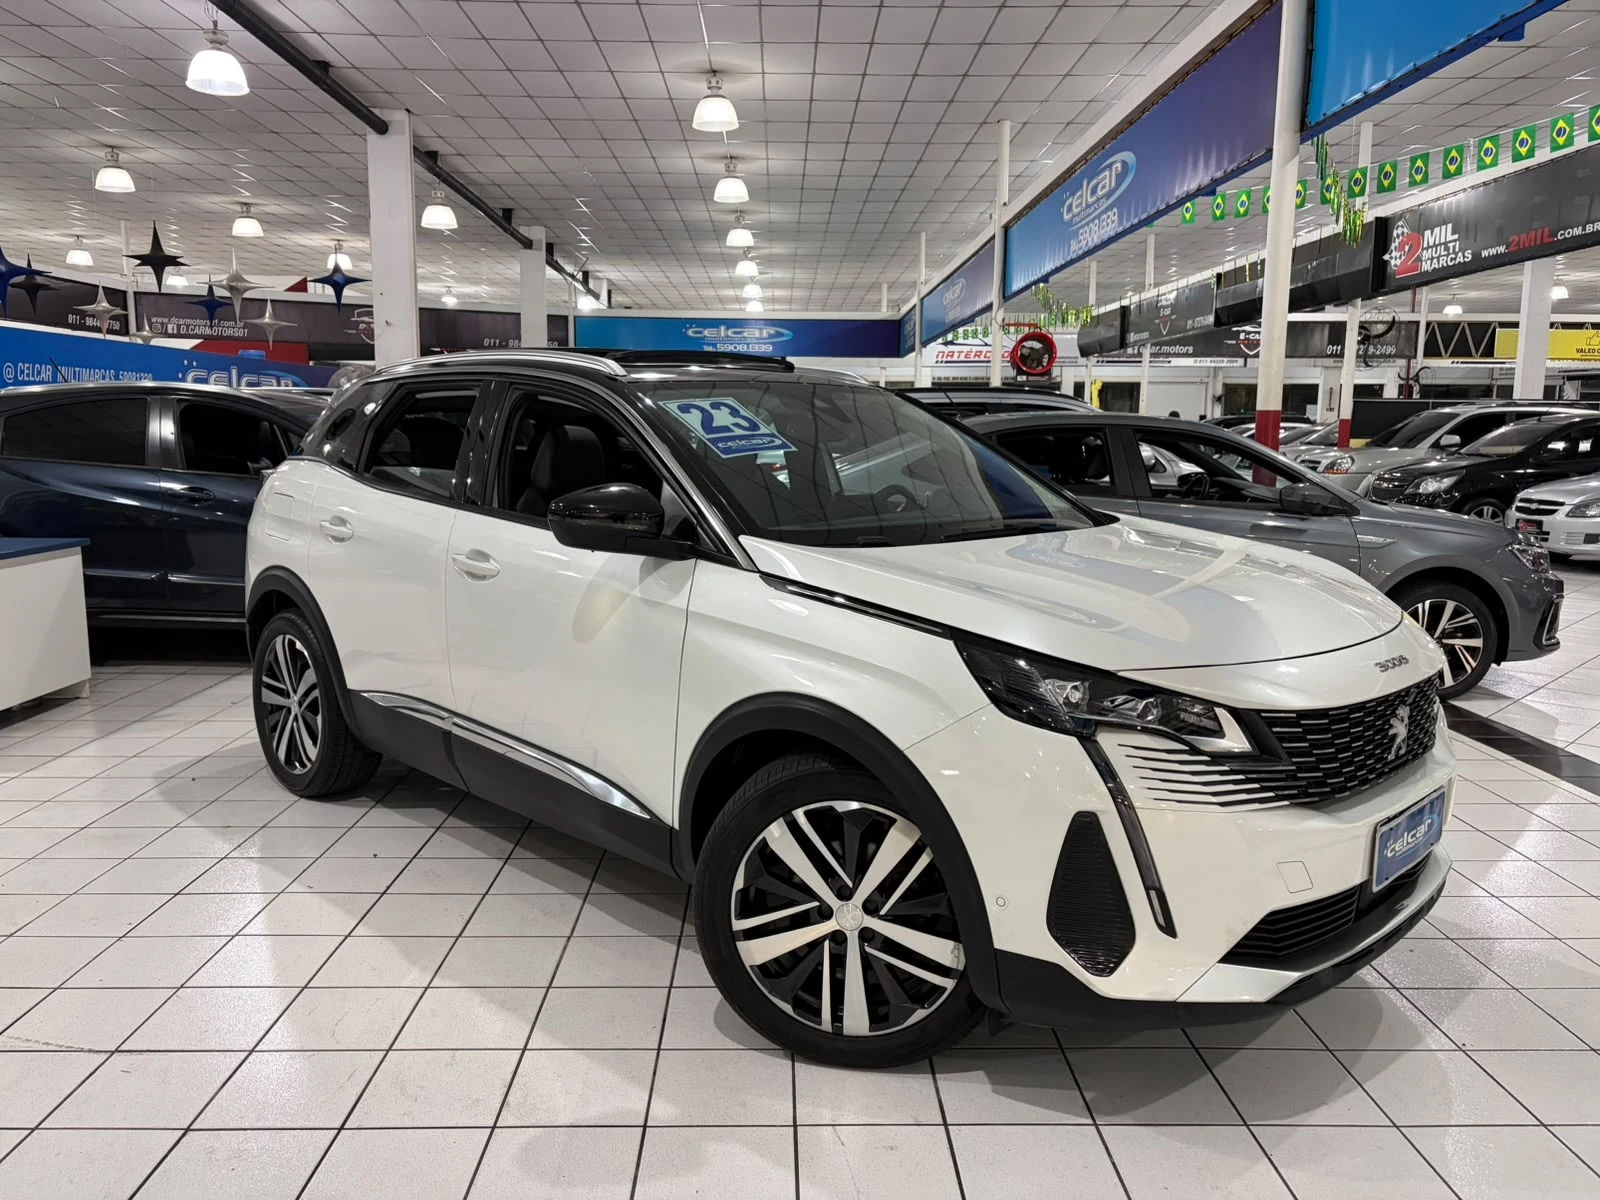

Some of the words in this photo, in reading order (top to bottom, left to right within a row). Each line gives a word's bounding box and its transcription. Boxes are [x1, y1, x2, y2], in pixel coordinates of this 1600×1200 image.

[1063, 159, 1123, 222] celcar
[1423, 223, 1459, 248] MIL
[1422, 241, 1460, 260] MULTI
[1421, 249, 1473, 273] MARCAS
[68, 314, 80, 325] 011
[180, 325, 248, 337] D.CARMOTORS01
[687, 325, 776, 338] celcar
[483, 338, 500, 347] 011
[1326, 345, 1341, 355] 011
[17, 362, 52, 382] CELCAR
[676, 402, 761, 436] 23
[1387, 819, 1432, 858] celcar
